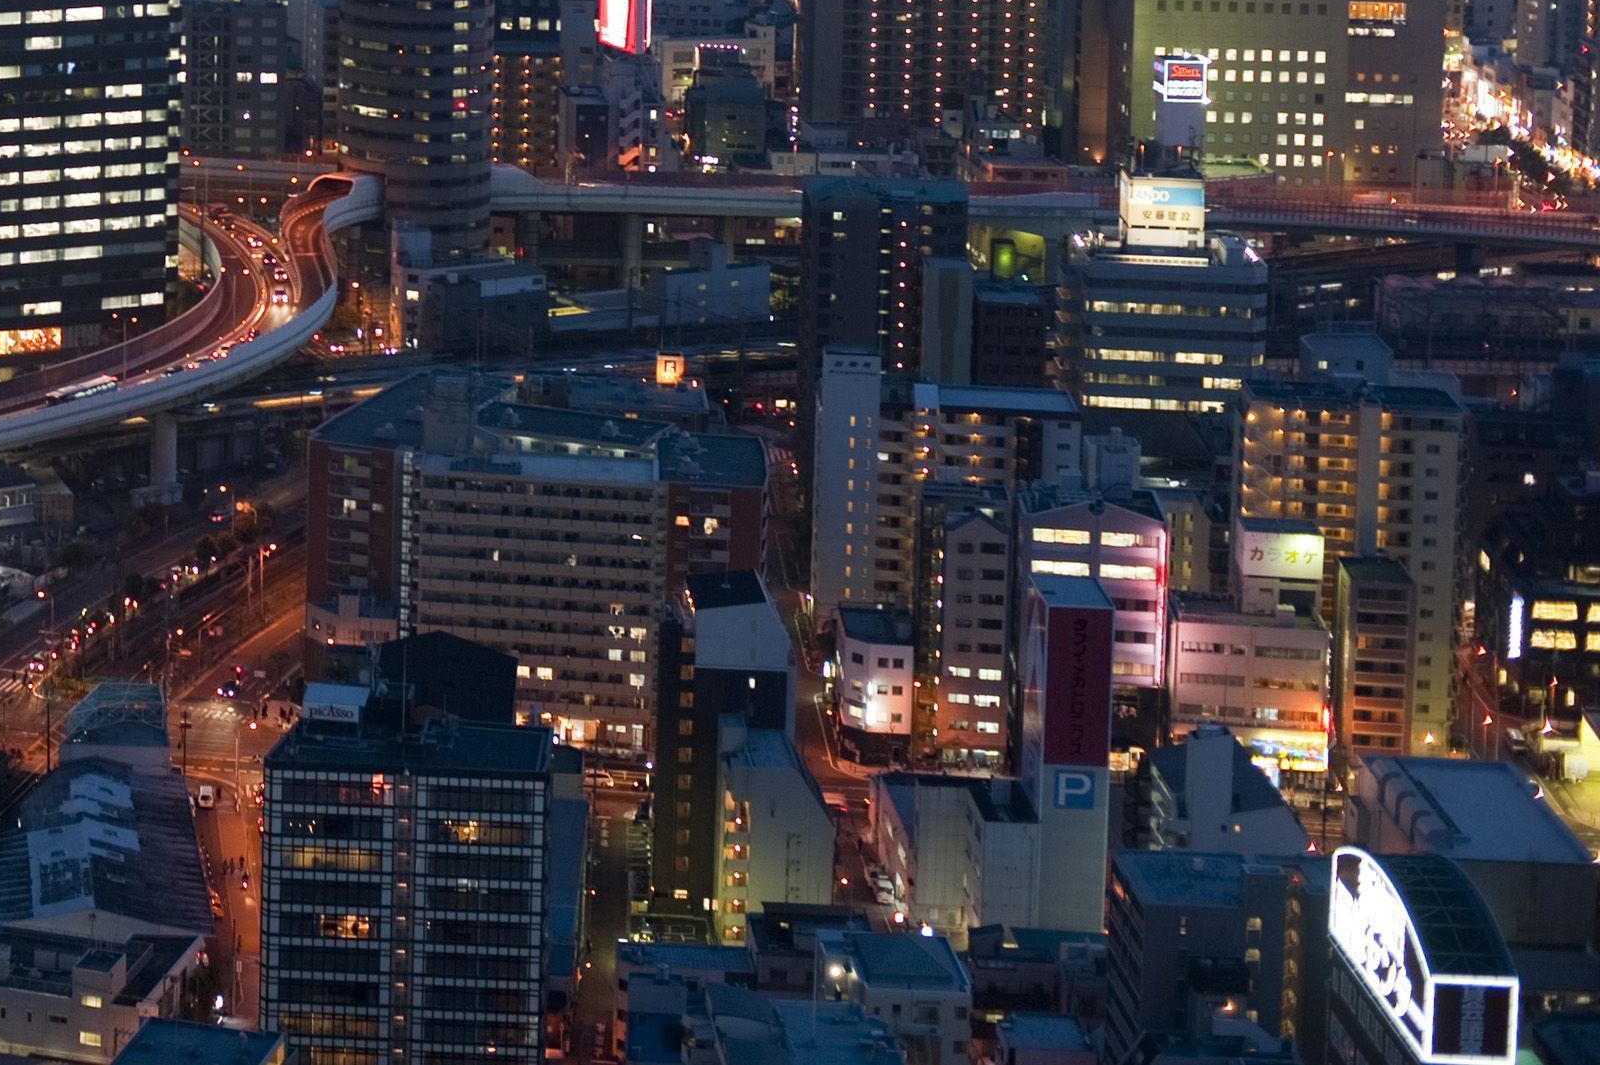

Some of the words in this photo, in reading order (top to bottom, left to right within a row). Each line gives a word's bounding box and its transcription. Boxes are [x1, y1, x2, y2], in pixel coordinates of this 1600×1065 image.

[1135, 190, 1170, 202] ANDO
[1142, 210, 1191, 222] 安藤建設
[1250, 546, 1318, 565] カラオケ
[1057, 773, 1092, 806] P
